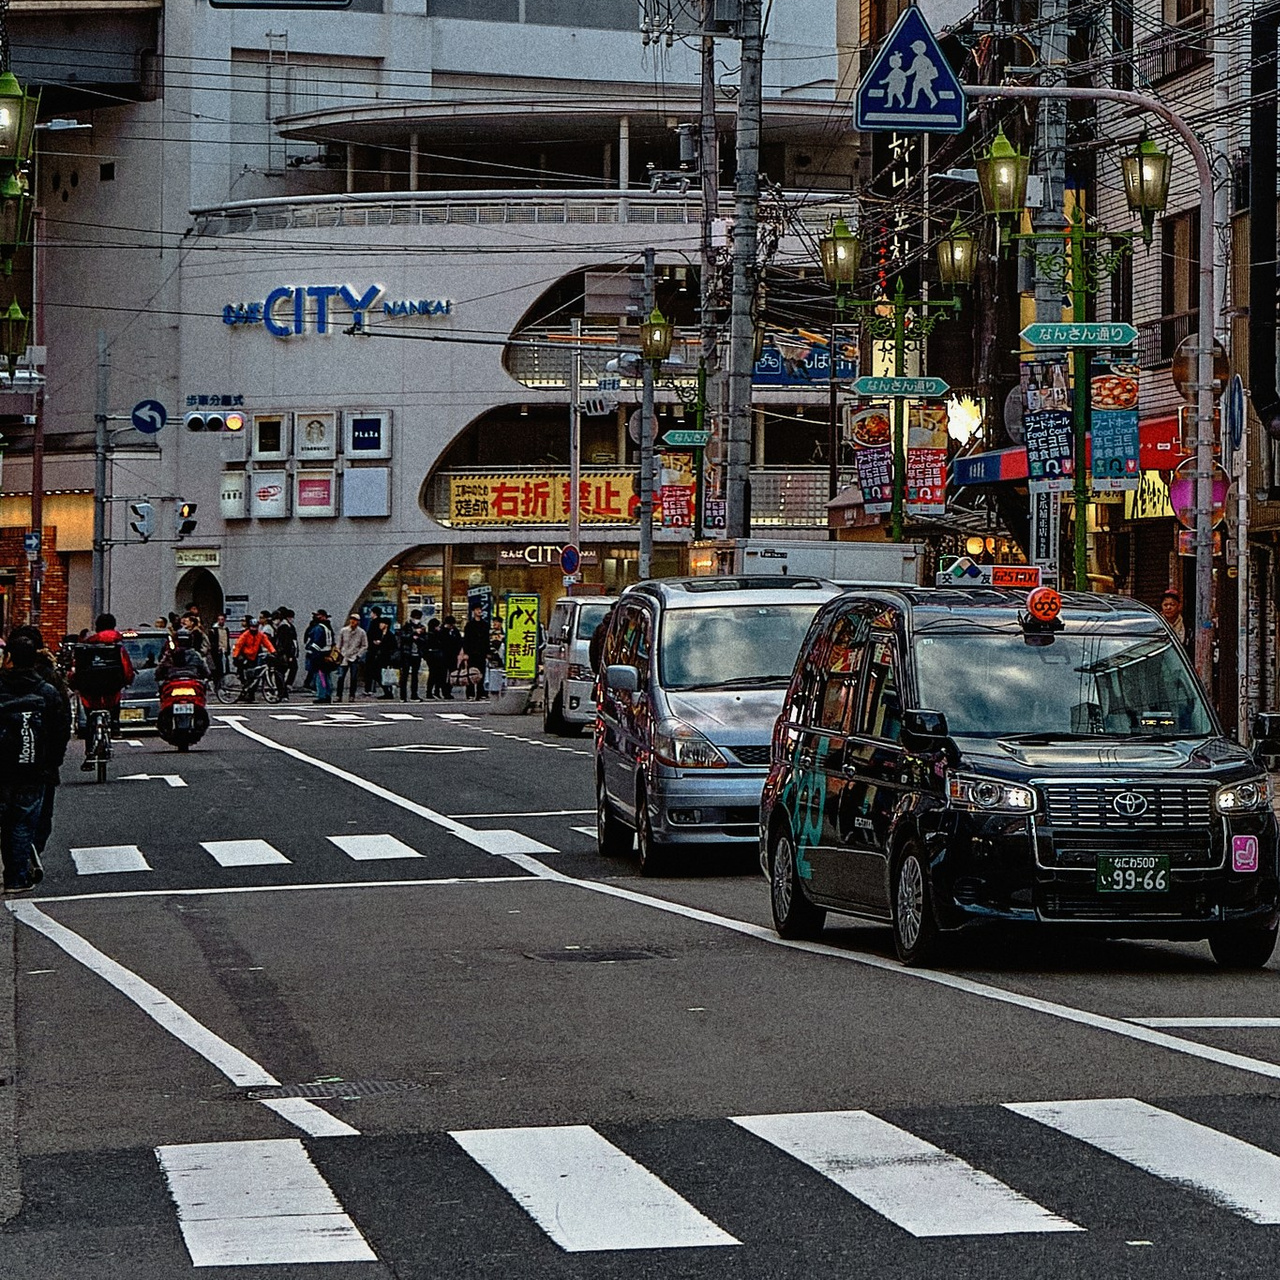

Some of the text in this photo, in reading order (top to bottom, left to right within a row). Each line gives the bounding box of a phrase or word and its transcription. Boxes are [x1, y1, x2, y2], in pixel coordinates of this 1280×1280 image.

[264, 285, 382, 336] CITY
[1038, 327, 1124, 341] なんさん通り
[866, 381, 936, 393] なんさん通り
[1027, 426, 1072, 440] Food Court
[490, 481, 550, 518] 右折
[562, 481, 622, 517] 禁止
[522, 630, 536, 657] 右折
[1113, 857, 1155, 869] なにわ500
[1113, 869, 1167, 890] 99-66
